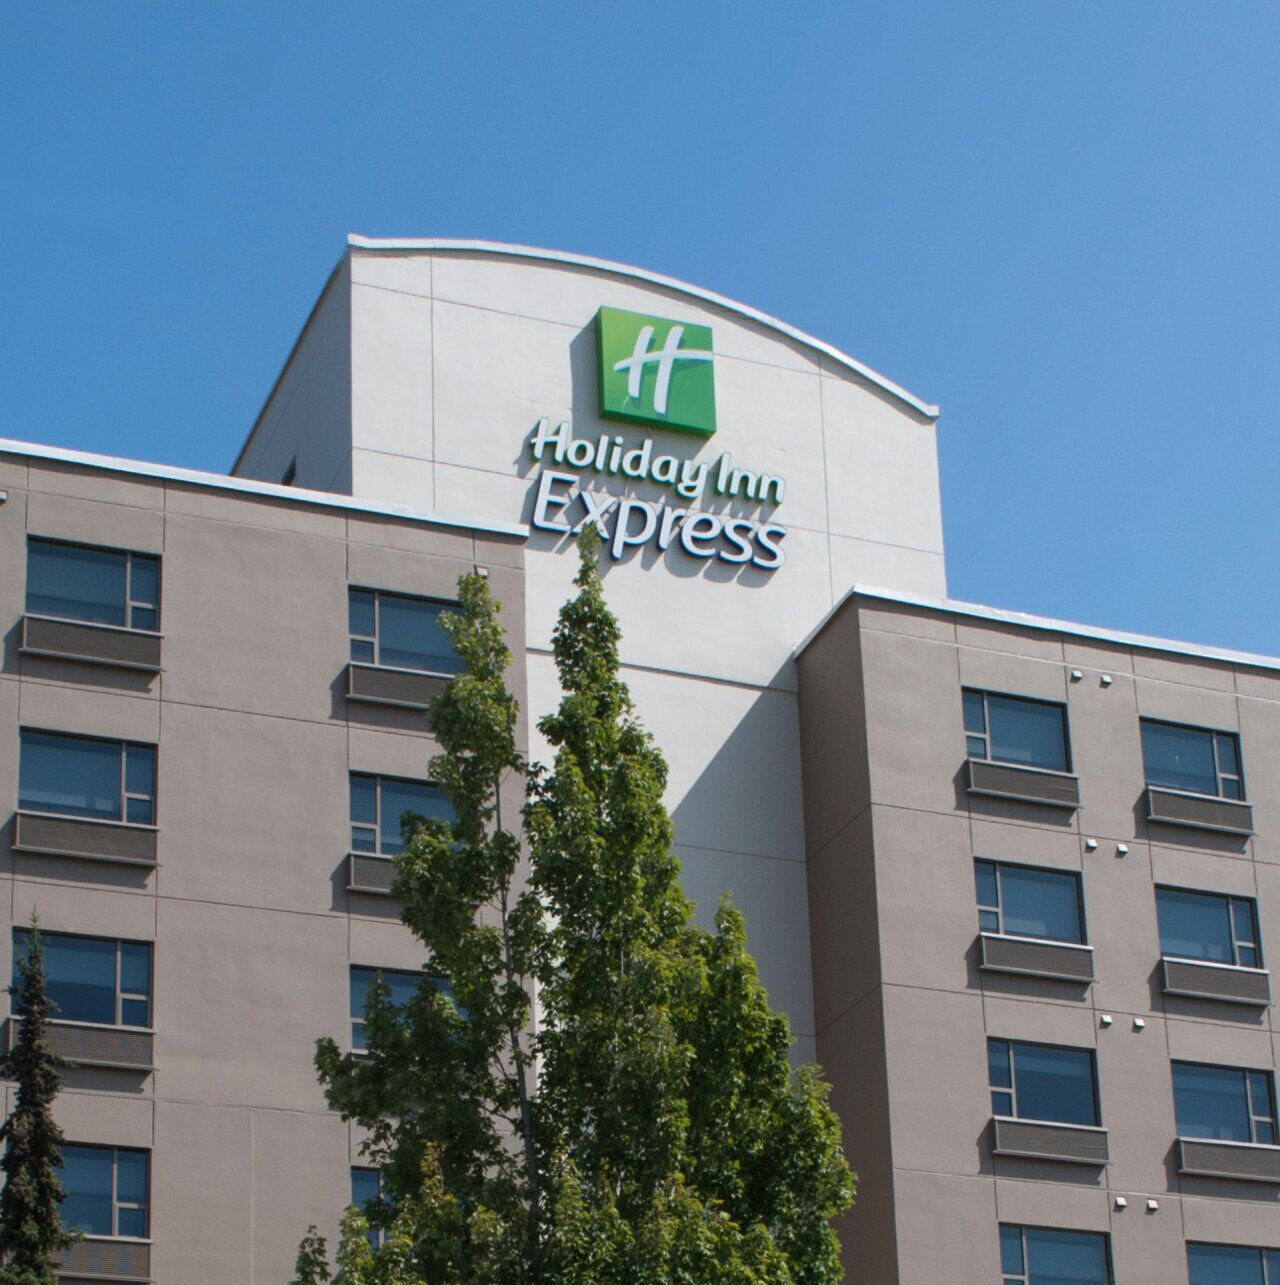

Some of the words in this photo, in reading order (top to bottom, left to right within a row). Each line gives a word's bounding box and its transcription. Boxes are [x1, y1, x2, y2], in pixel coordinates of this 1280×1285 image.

[613, 326, 713, 415] H
[530, 417, 707, 499] Holiday
[715, 452, 786, 504] Inn
[532, 469, 788, 570] Express
